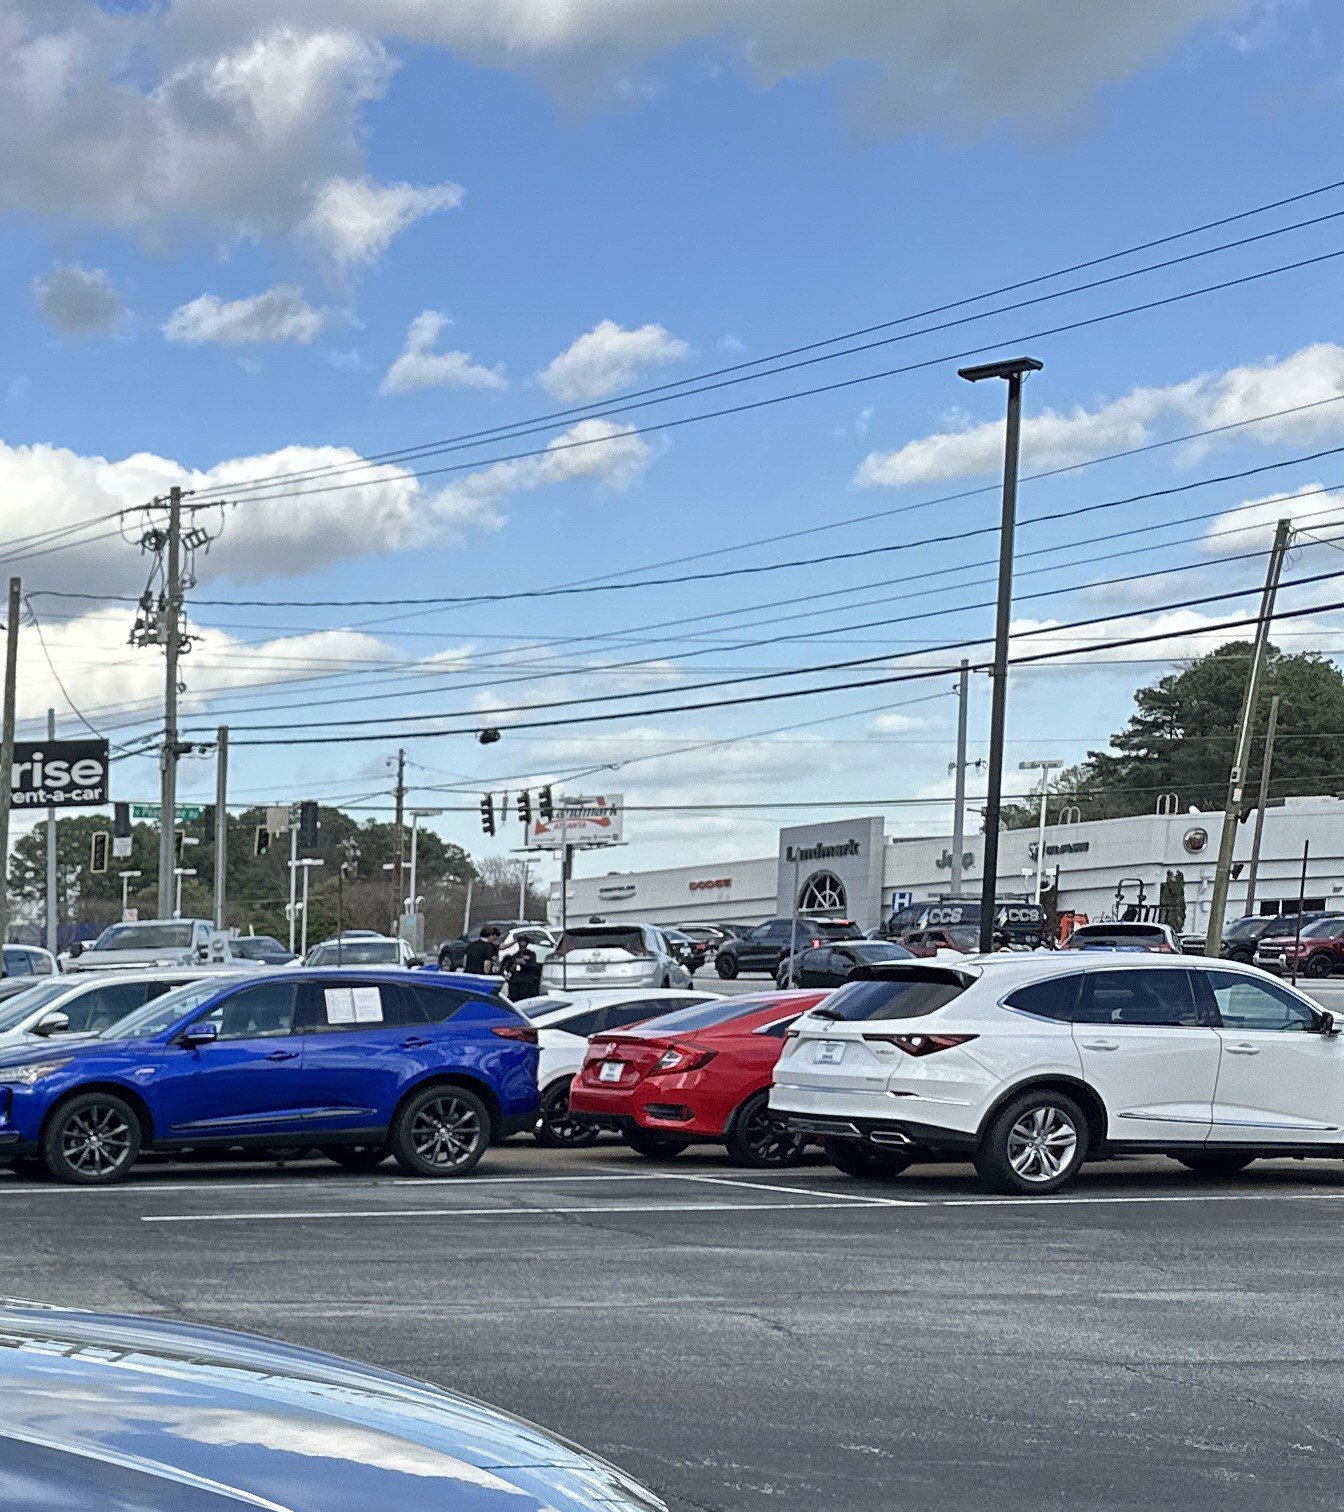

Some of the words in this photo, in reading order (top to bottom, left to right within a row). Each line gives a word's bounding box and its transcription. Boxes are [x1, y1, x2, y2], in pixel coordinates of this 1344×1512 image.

[11, 788, 103, 804] ent-a-car
[929, 907, 963, 924] CCS
[1008, 908, 1039, 922] CCS
